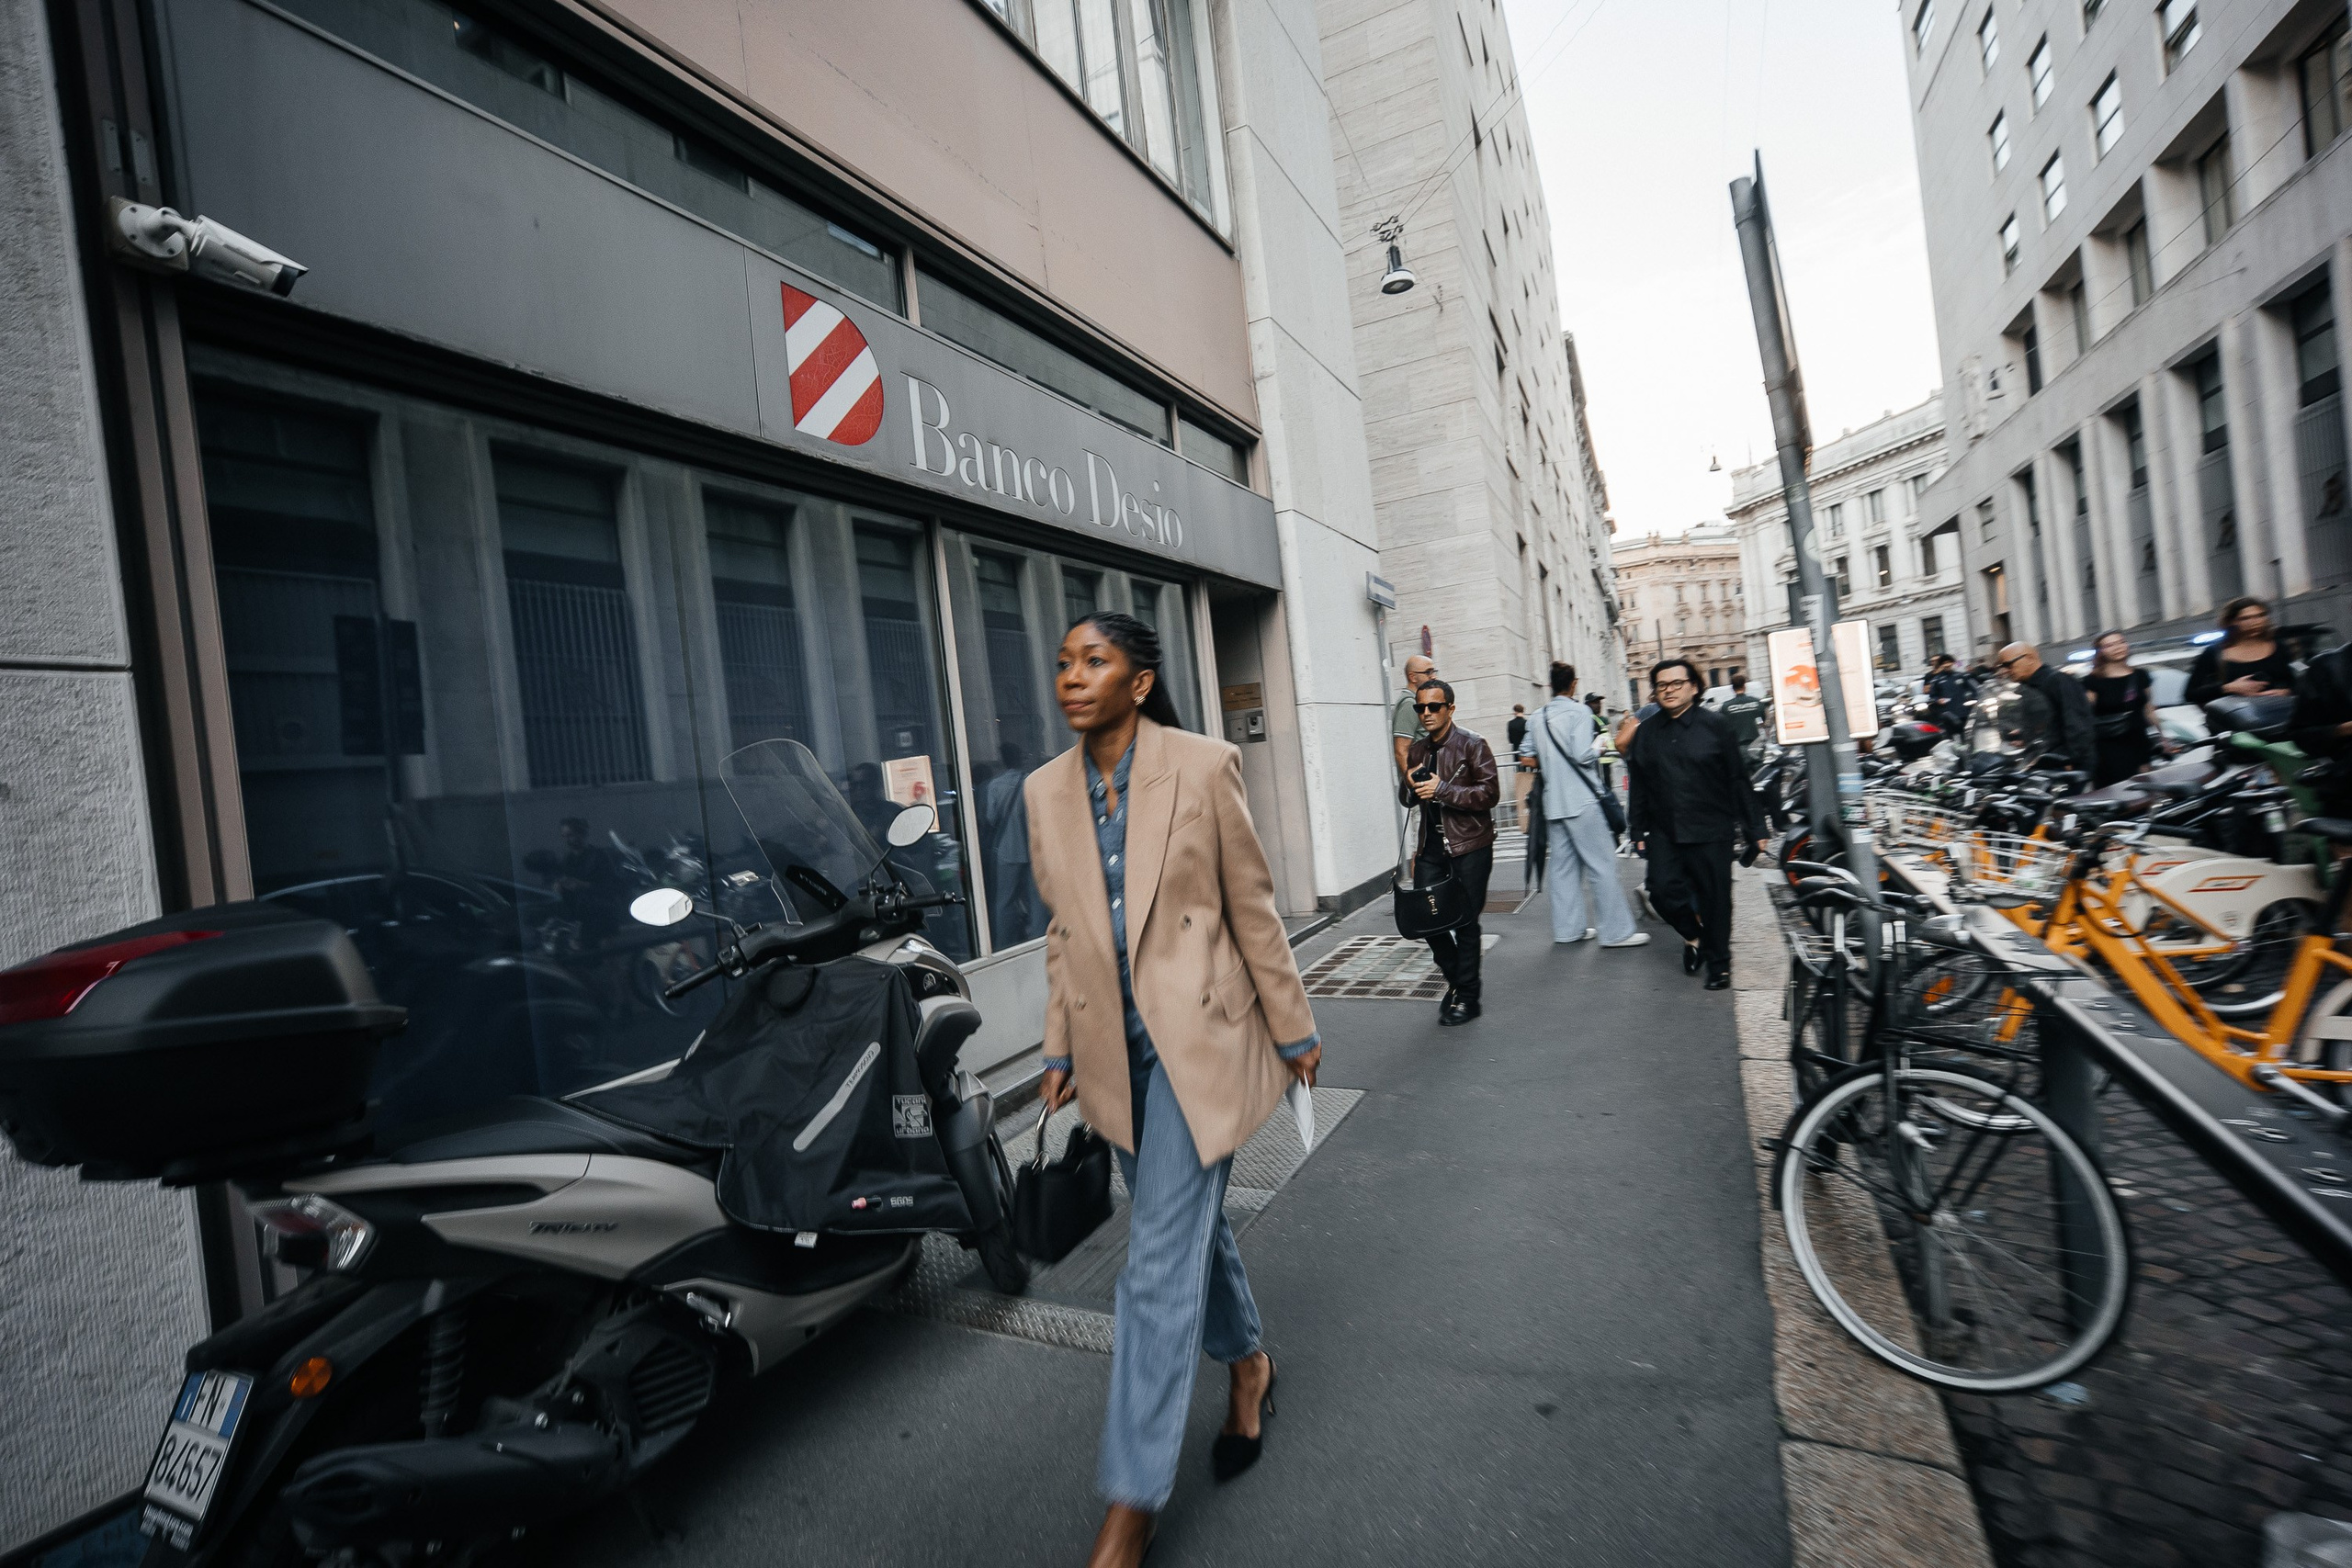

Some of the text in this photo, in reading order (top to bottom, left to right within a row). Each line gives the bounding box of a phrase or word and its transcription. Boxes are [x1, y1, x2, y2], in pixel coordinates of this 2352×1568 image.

[900, 370, 1183, 548] Banco Desio
[188, 1373, 227, 1429] FN
[154, 1434, 221, 1504] 84657
